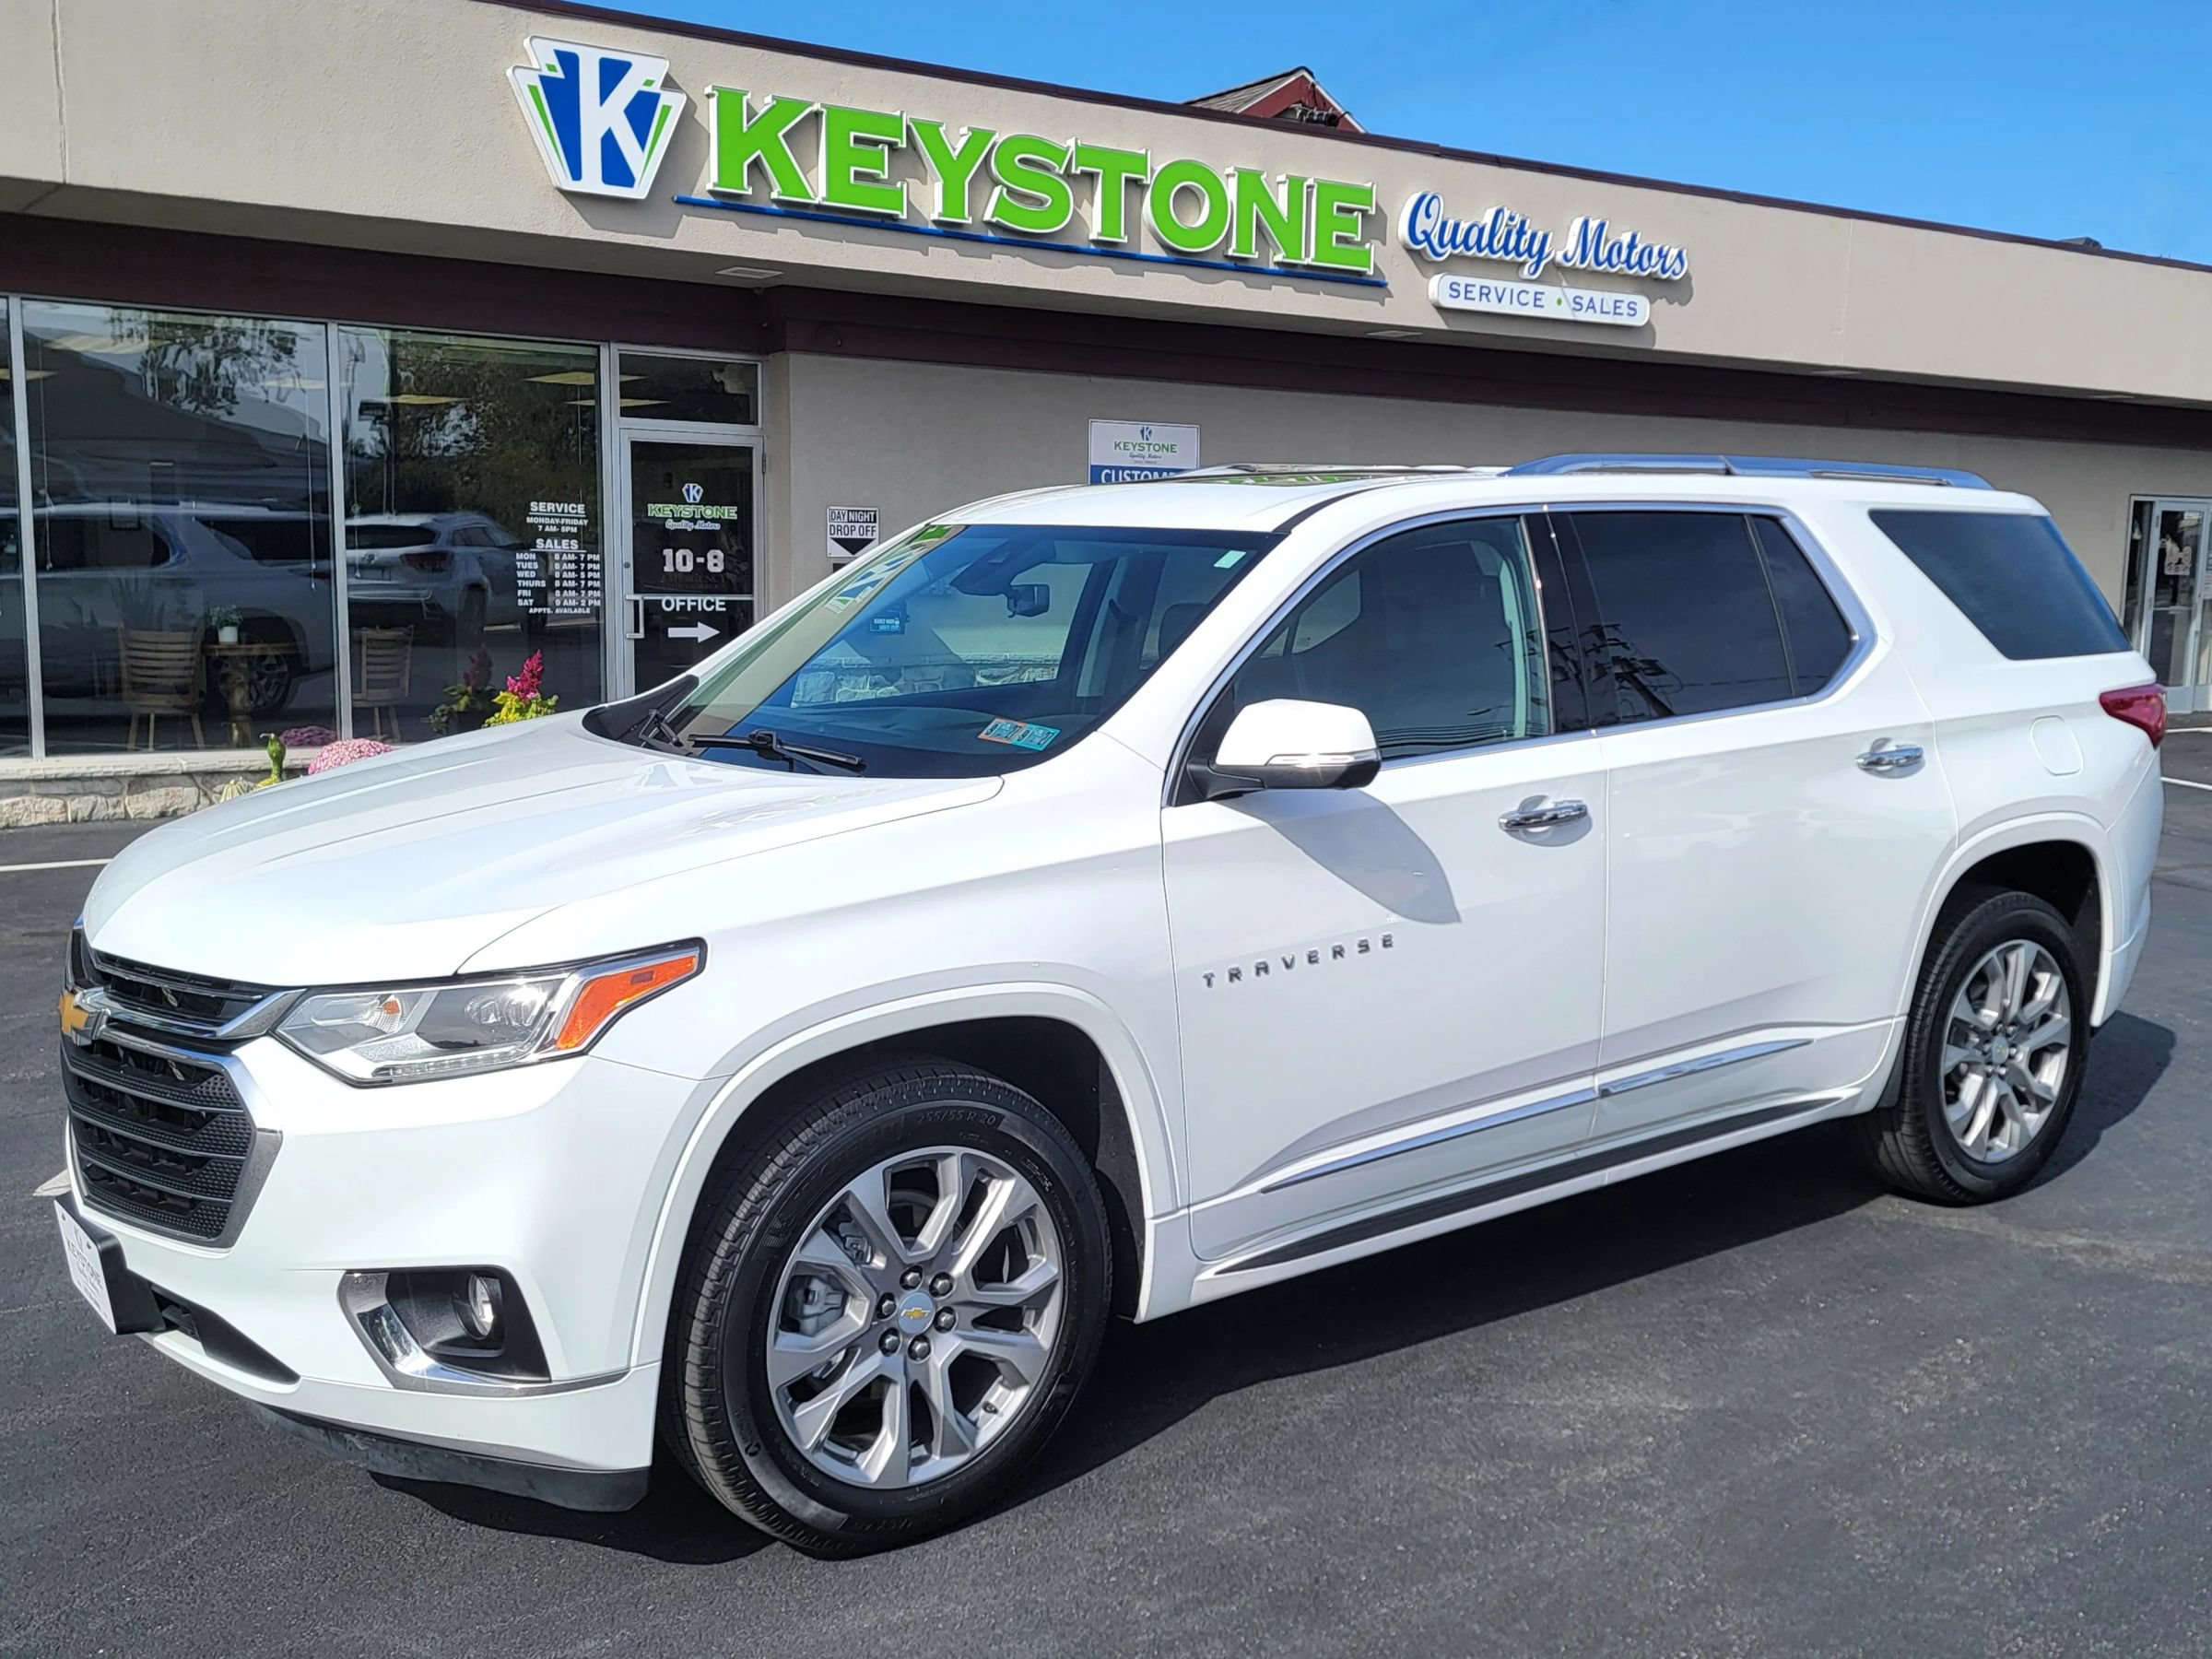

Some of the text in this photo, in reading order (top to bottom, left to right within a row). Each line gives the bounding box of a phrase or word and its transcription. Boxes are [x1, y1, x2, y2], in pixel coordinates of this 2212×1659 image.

[708, 86, 1373, 276] KEYSTONE
[1403, 191, 1688, 280] Quality Motors
[1448, 281, 1638, 317] SERVICE SALES
[1113, 441, 1178, 453] KEYSTONE
[1100, 468, 1179, 484] CUSTO
[530, 501, 586, 514] SERVICE
[647, 503, 737, 520] KEYSTONE
[526, 517, 588, 525] MONDAY-FRIDAY
[830, 510, 877, 523] DAY NIGHT
[830, 524, 877, 536] DROP OFF
[535, 538, 579, 550] SALES
[516, 561, 538, 570] TUES
[663, 548, 724, 573] 10-8
[587, 571, 600, 580] PM
[517, 580, 547, 588] THURS
[588, 580, 601, 588] PM
[588, 590, 601, 598] PM
[588, 599, 601, 607] PM
[661, 595, 726, 612] OFFICE
[1202, 933, 1395, 989] TRAVERSE
[979, 1112, 996, 1125] 20
